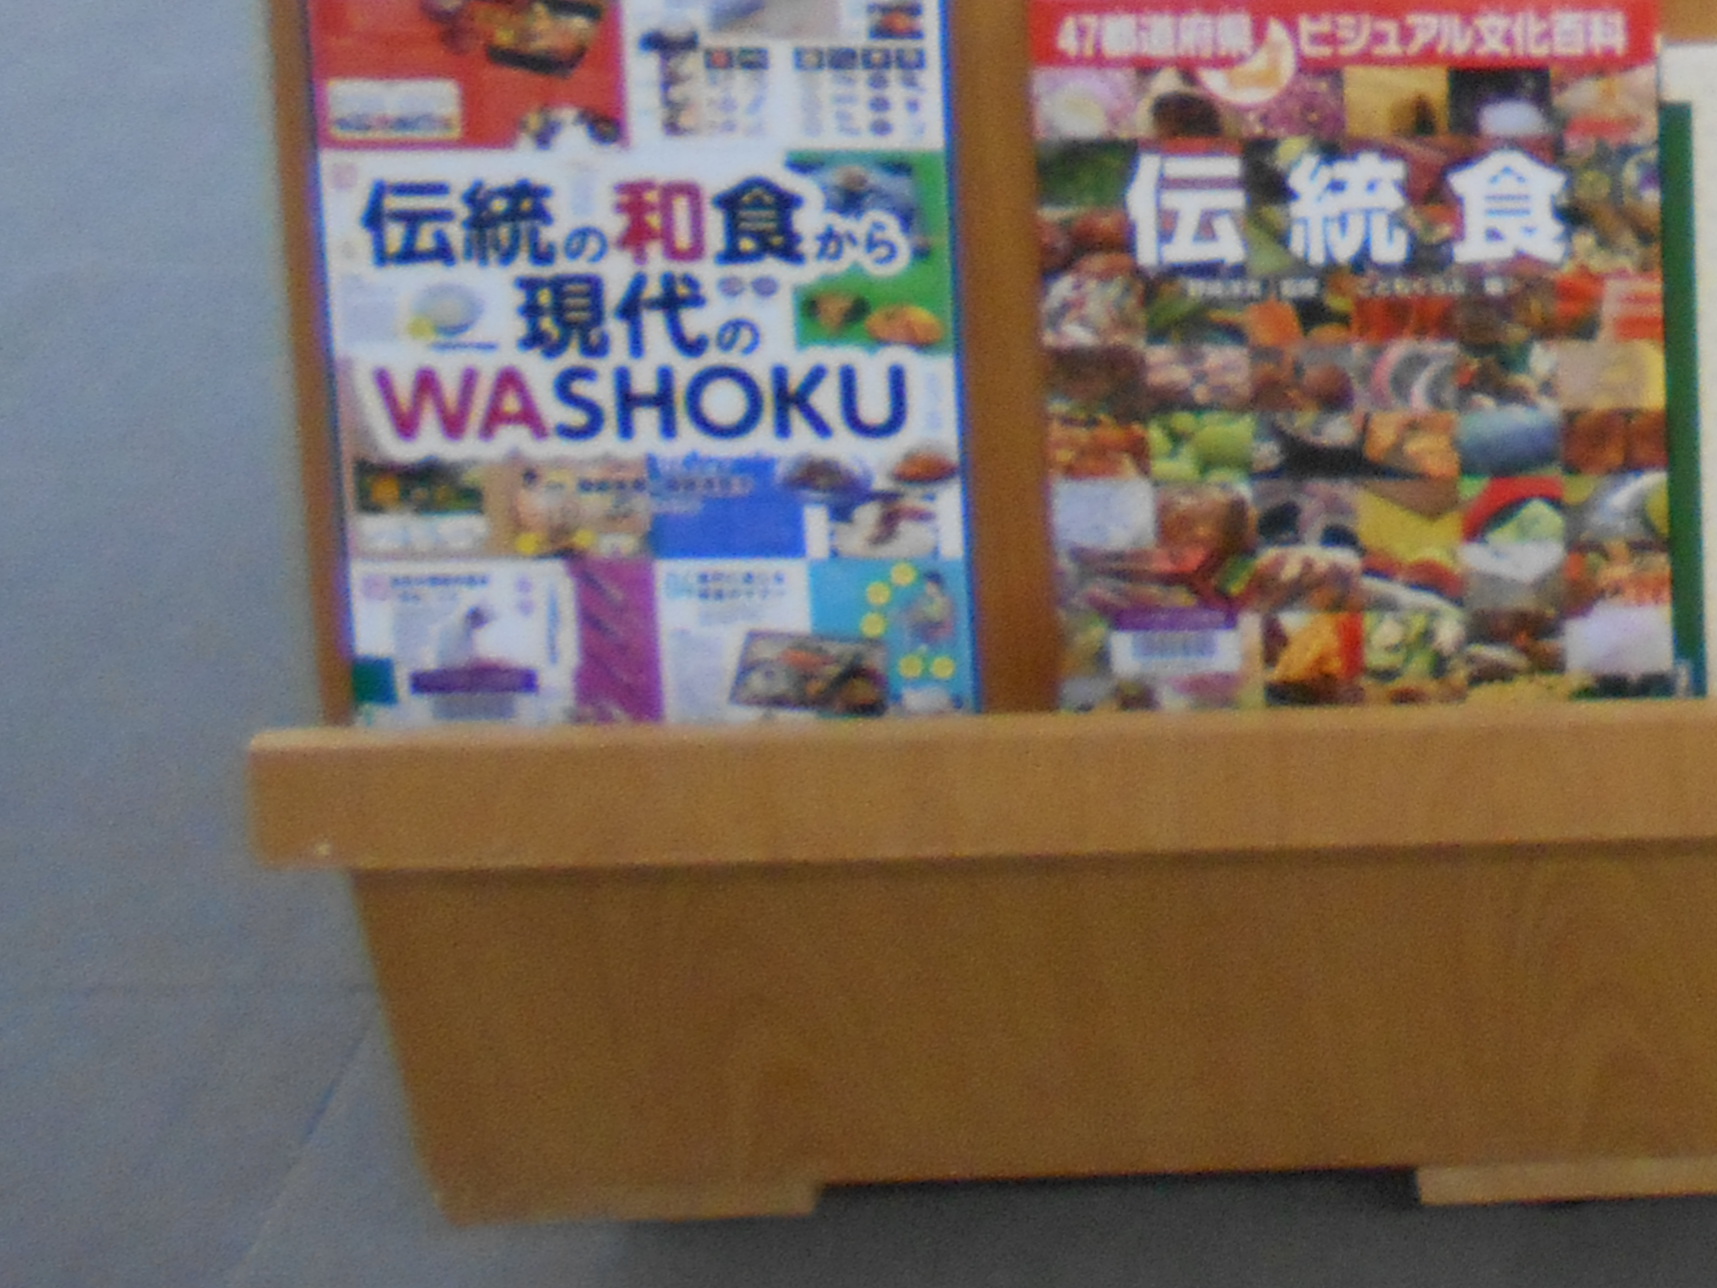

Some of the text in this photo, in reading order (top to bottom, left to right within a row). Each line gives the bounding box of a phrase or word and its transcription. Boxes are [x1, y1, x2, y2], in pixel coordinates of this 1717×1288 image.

[360, 174, 899, 268] 伝統の和食から
[1126, 148, 1569, 270] 伝統食
[513, 271, 763, 360] 現代の
[371, 361, 911, 443] WASHOKU
